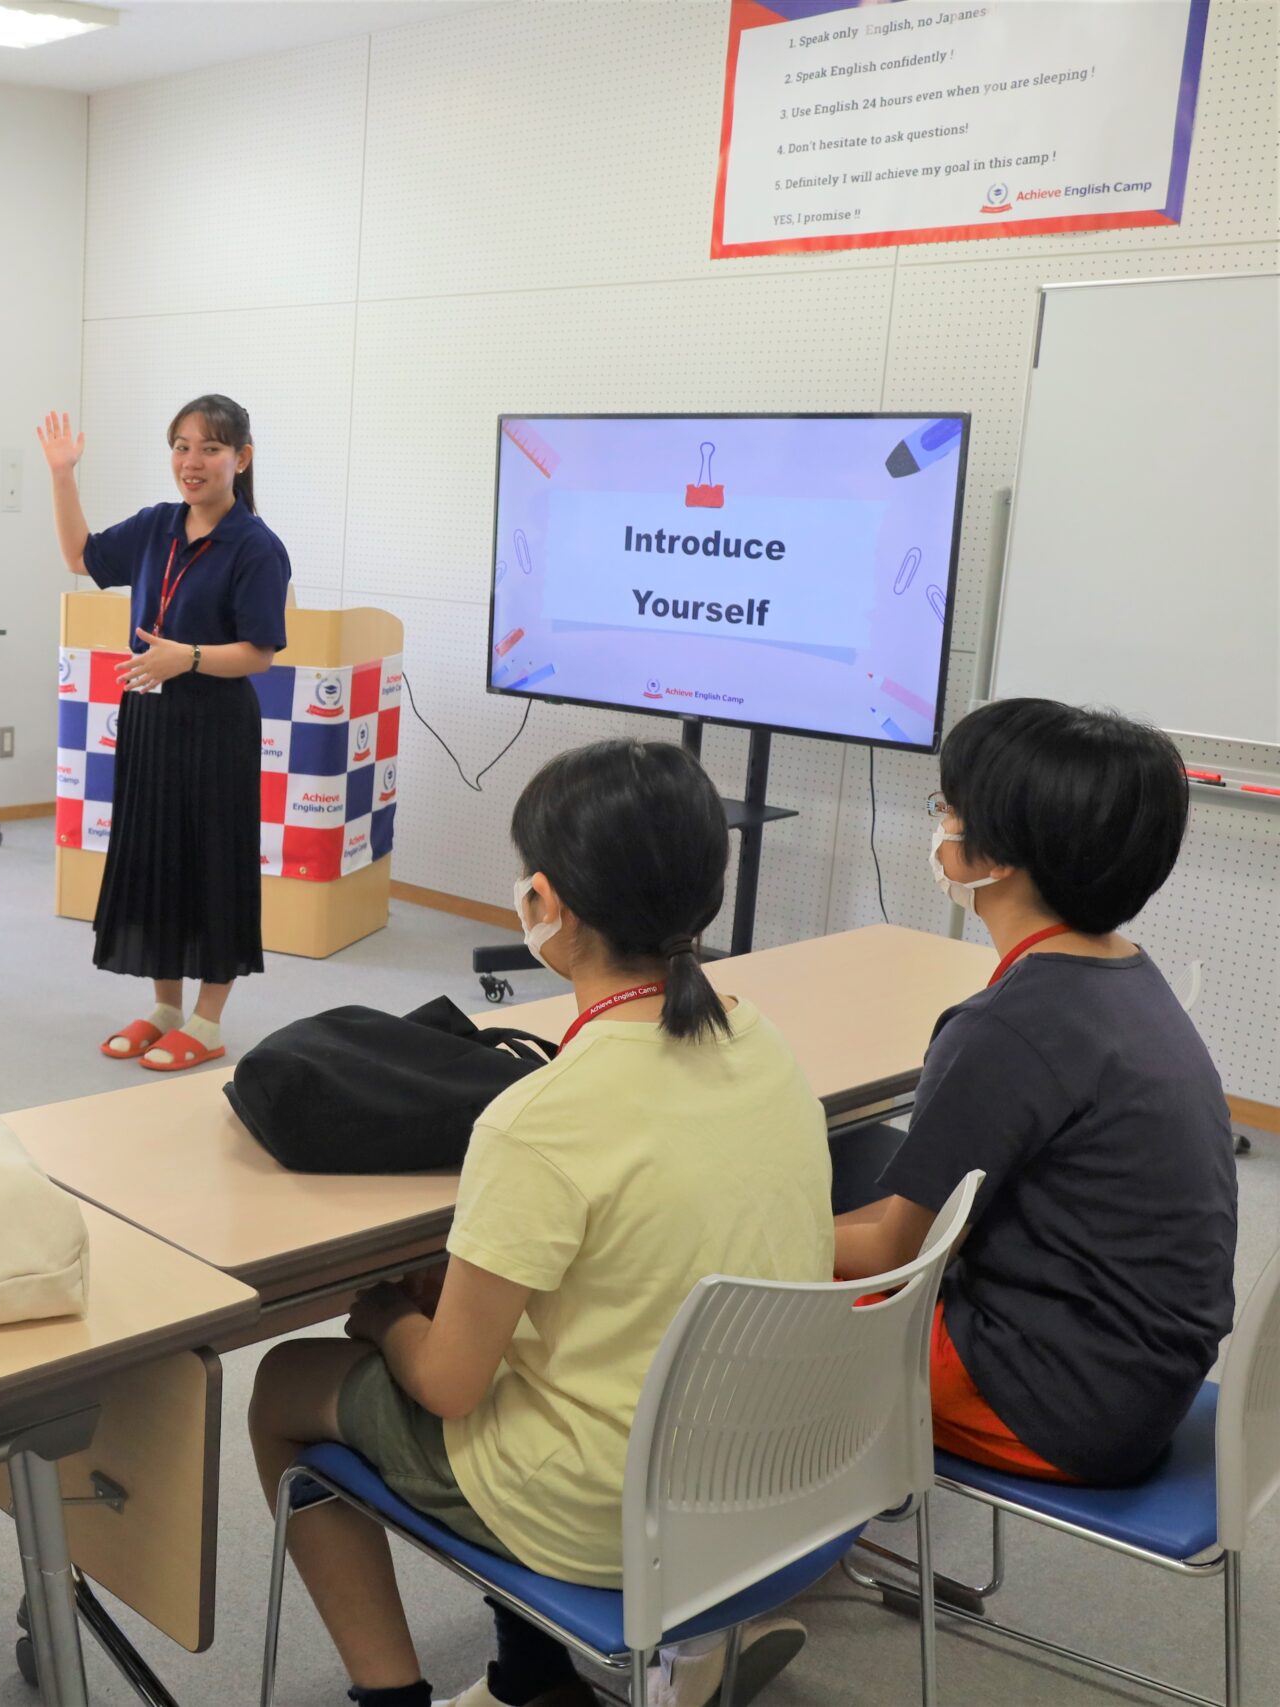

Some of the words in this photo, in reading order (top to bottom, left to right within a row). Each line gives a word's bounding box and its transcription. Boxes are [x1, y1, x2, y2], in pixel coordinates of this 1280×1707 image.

[788, 39, 796, 48] 1.
[799, 31, 830, 47] Speak
[832, 27, 859, 40] only
[865, 20, 914, 37] English,
[917, 17, 933, 28] no
[784, 74, 793, 84] 2.
[796, 67, 827, 83] Speak
[830, 61, 876, 77] English
[880, 50, 947, 71] confidently
[780, 109, 789, 119] 3.
[791, 107, 811, 118] Use
[814, 100, 859, 115] English
[862, 99, 877, 110] 24
[880, 96, 913, 108] hours
[916, 90, 943, 102] even
[946, 85, 980, 98] when
[984, 81, 1007, 96] you
[1010, 78, 1029, 90] are
[1033, 68, 1088, 86] sleeping
[777, 145, 786, 155] 4.
[788, 141, 816, 154] Don't
[819, 136, 868, 151] hesitate
[870, 135, 882, 145] to
[885, 131, 904, 144] ask
[906, 123, 969, 142] questions!
[775, 180, 782, 190] 5.
[785, 174, 839, 189] Definitely
[842, 173, 848, 184] I
[850, 171, 872, 183] will
[875, 168, 919, 181] achieve
[921, 165, 942, 177] my
[944, 160, 970, 176] goal
[973, 159, 986, 171] in
[989, 157, 1013, 170] this
[1015, 152, 1049, 167] camp
[1016, 188, 1061, 201] Achieve
[1064, 183, 1110, 198] English
[1113, 181, 1152, 193] Camp
[773, 214, 795, 226] YES,
[804, 210, 851, 225] promise
[624, 526, 786, 561] Introduce
[632, 589, 770, 626] Yourself
[665, 688, 693, 698] Achieve
[694, 691, 721, 701] English
[722, 694, 744, 704] Camp
[590, 999, 613, 1014] Achieve
[613, 990, 638, 1002] English
[638, 986, 657, 995] Camp
